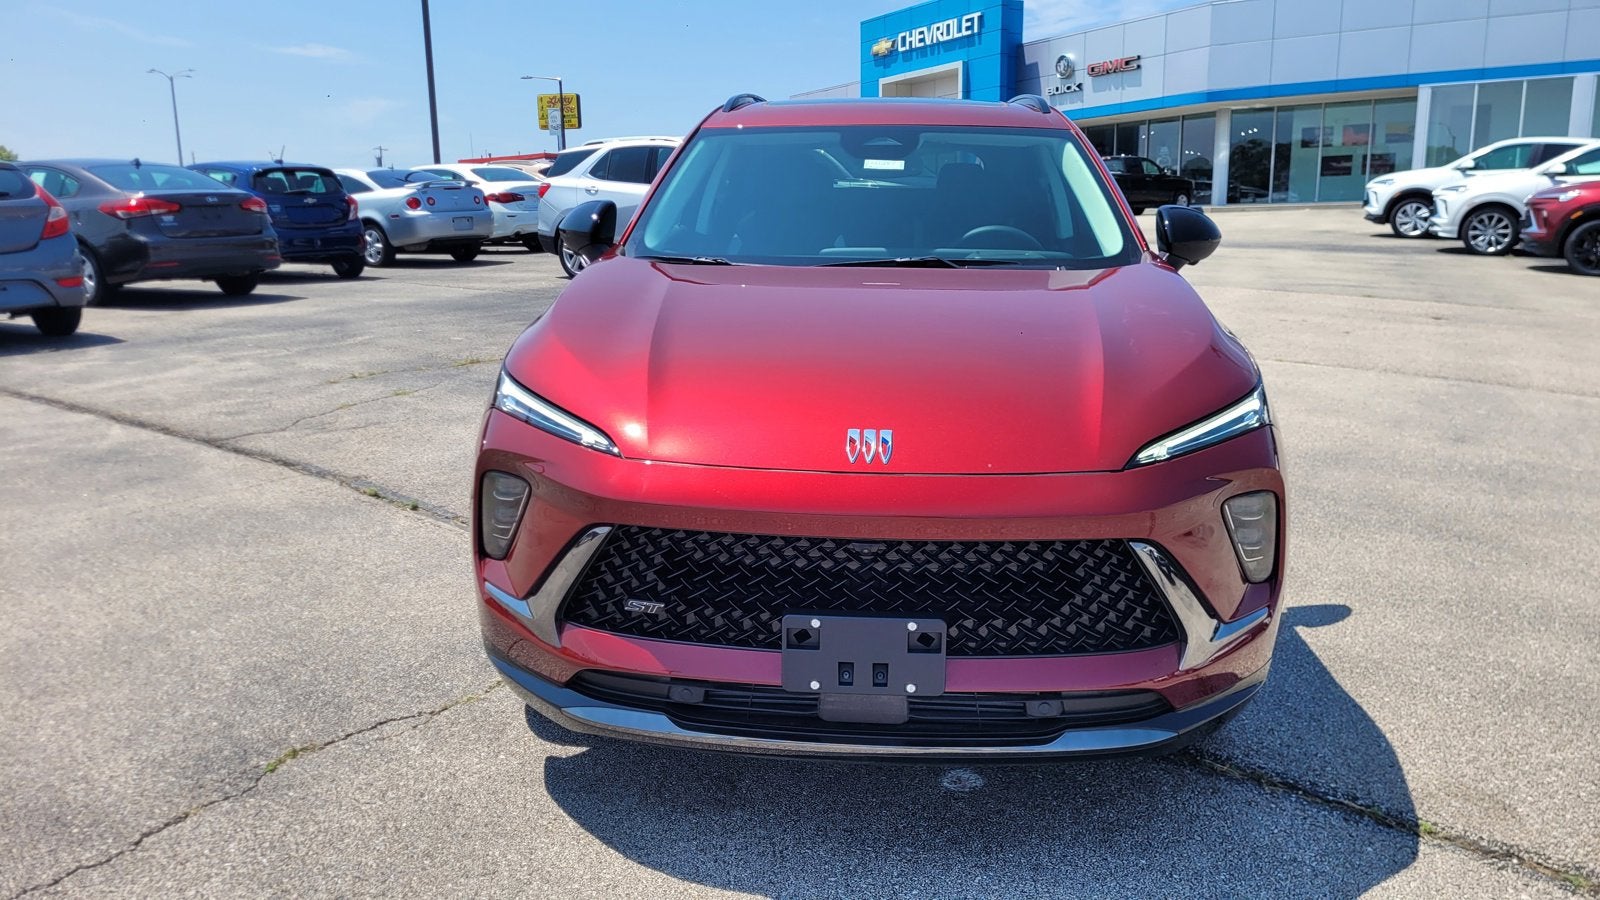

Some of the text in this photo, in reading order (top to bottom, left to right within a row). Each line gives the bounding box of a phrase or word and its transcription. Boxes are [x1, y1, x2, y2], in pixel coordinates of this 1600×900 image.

[897, 12, 982, 52] CHEVROLET
[1088, 56, 1140, 77] GMC
[1046, 83, 1082, 95] BUICK
[624, 599, 664, 613] ST
